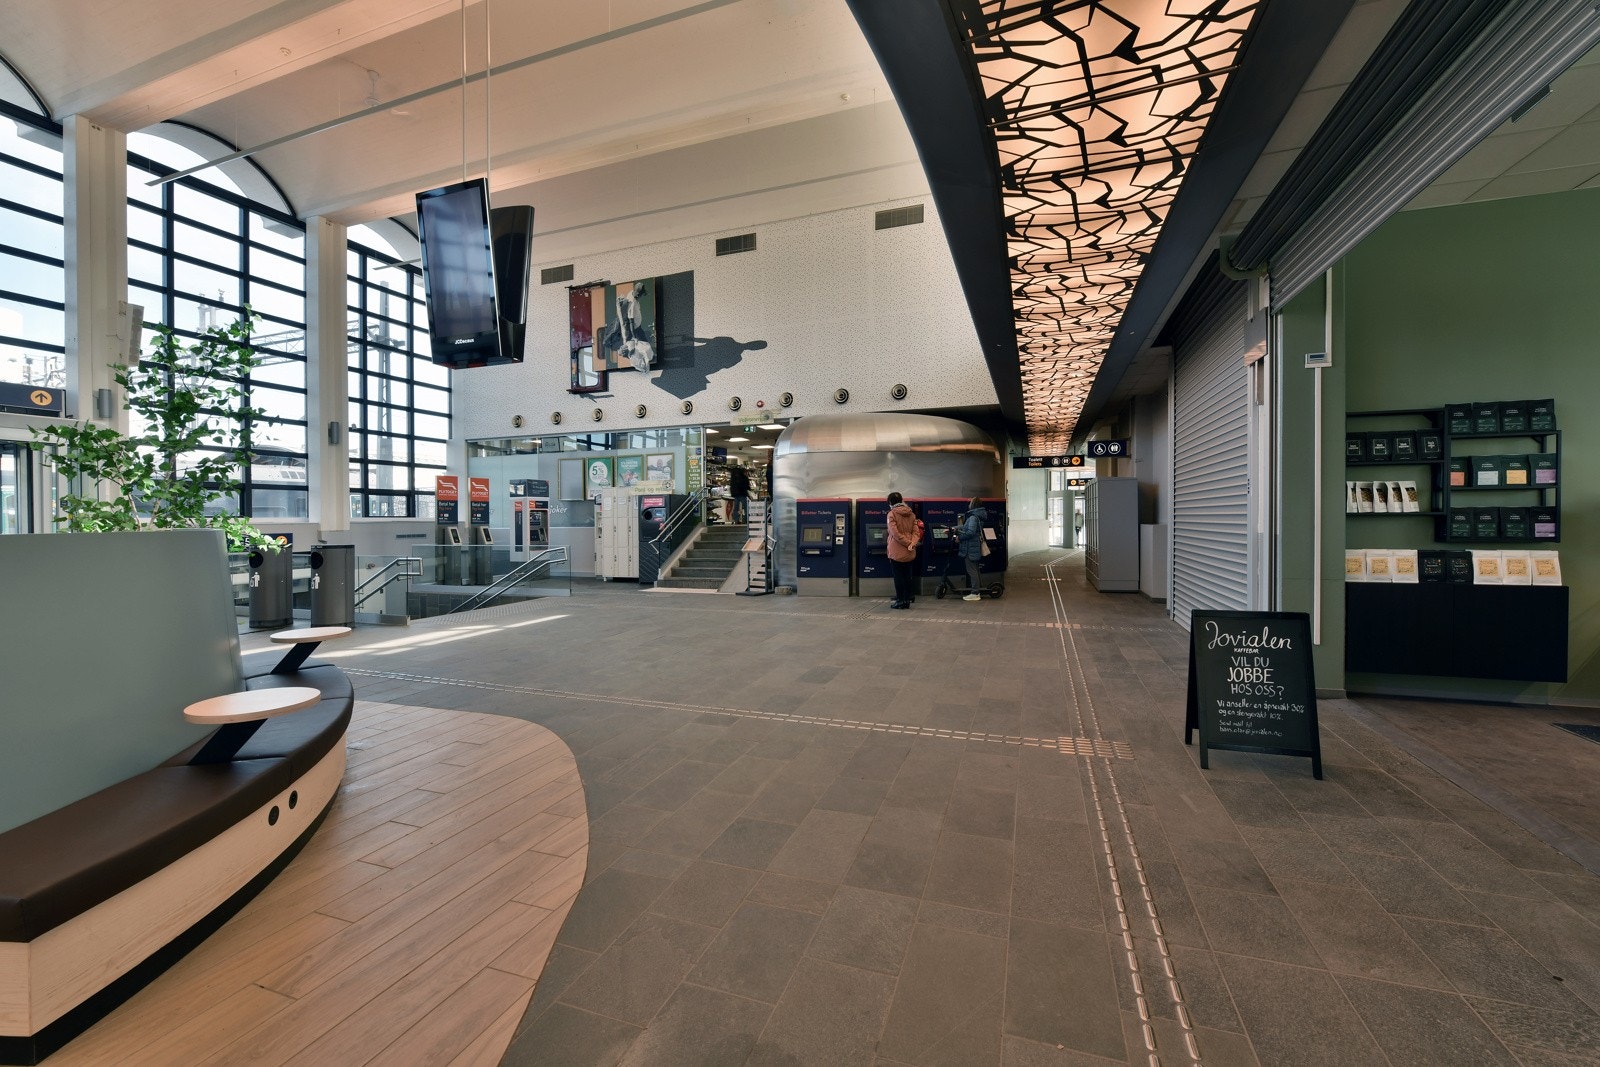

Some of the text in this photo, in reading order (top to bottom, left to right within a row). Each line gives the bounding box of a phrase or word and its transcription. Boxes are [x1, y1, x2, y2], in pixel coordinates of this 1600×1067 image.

[1206, 621, 1292, 650] Jovialen
[1231, 656, 1269, 668] VIL DU
[1227, 667, 1274, 684] JOBBE
[1231, 683, 1252, 695] HOS
[1216, 699, 1225, 708] Vi
